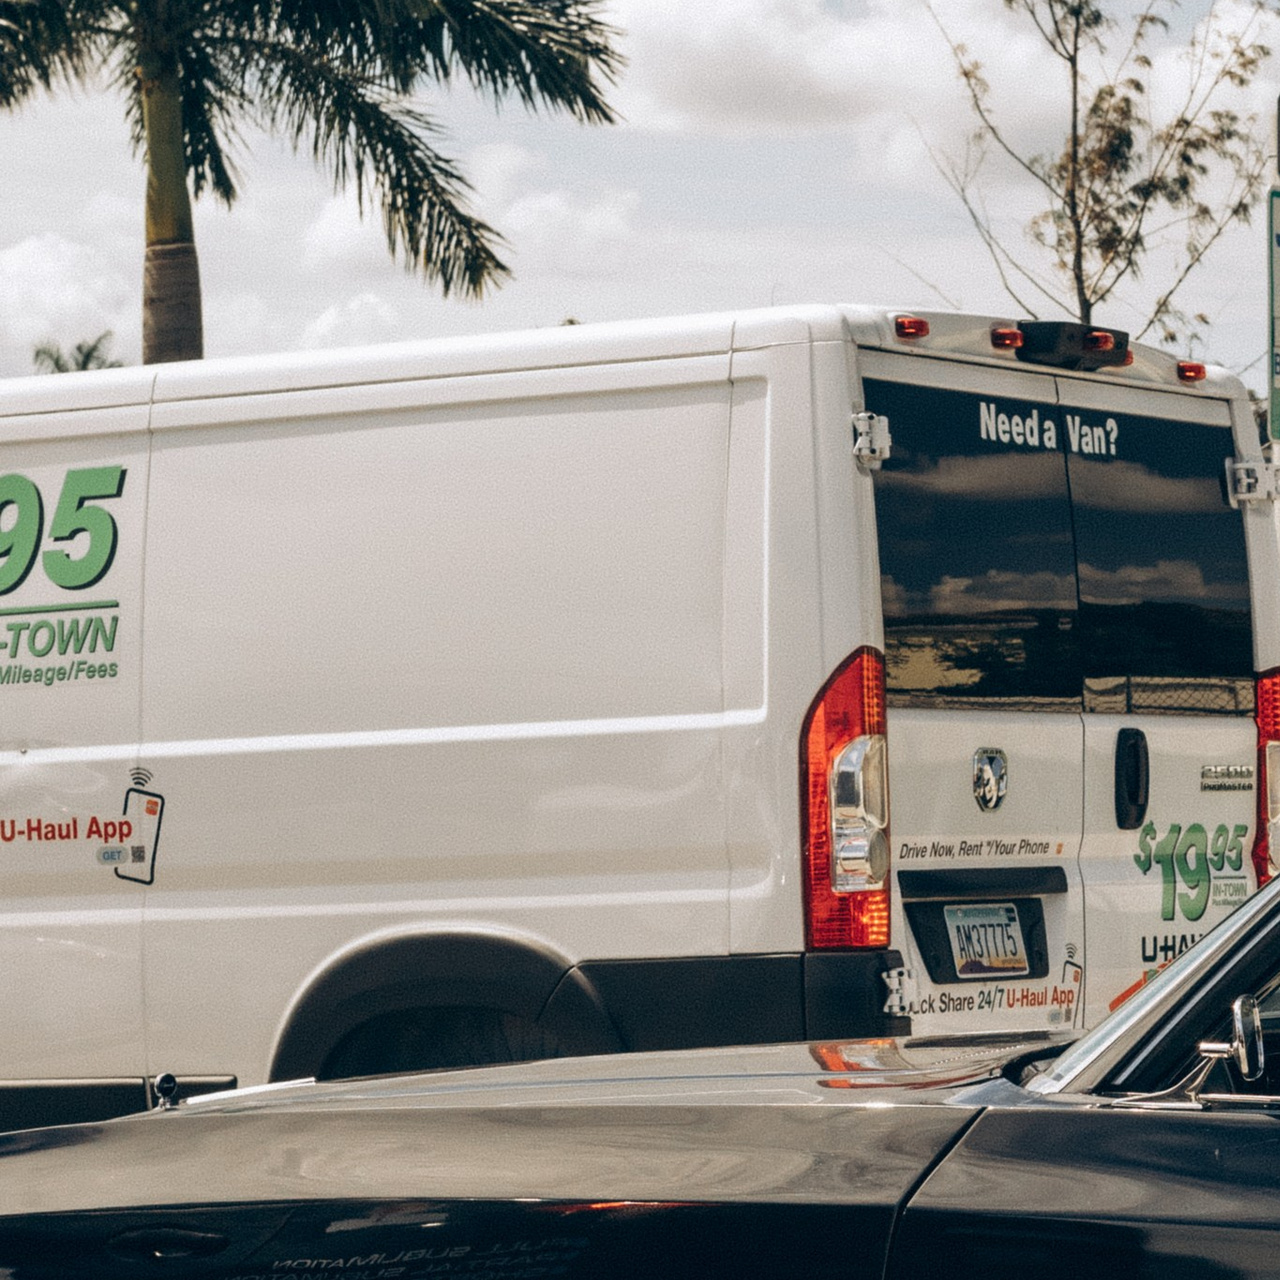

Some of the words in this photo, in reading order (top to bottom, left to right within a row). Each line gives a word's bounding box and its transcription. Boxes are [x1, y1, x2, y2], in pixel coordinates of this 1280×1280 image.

[979, 401, 1040, 447] Need
[1043, 419, 1057, 450] a
[1065, 414, 1119, 456] Van?
[0, 816, 79, 843] U-Haul
[86, 815, 133, 844] App
[101, 849, 123, 861] GET
[899, 842, 928, 860] Drive
[929, 840, 955, 860] Now,
[958, 840, 984, 857] Rent
[1018, 838, 1051, 856] Phone
[1211, 882, 1248, 897] IN-TOWN
[955, 922, 1019, 960] AM37775
[1141, 933, 1204, 963] U-HA
[938, 991, 975, 1013] Share
[977, 985, 1006, 1014] 24/7
[1006, 986, 1049, 1009] U-Haul
[1051, 985, 1075, 1010] App
